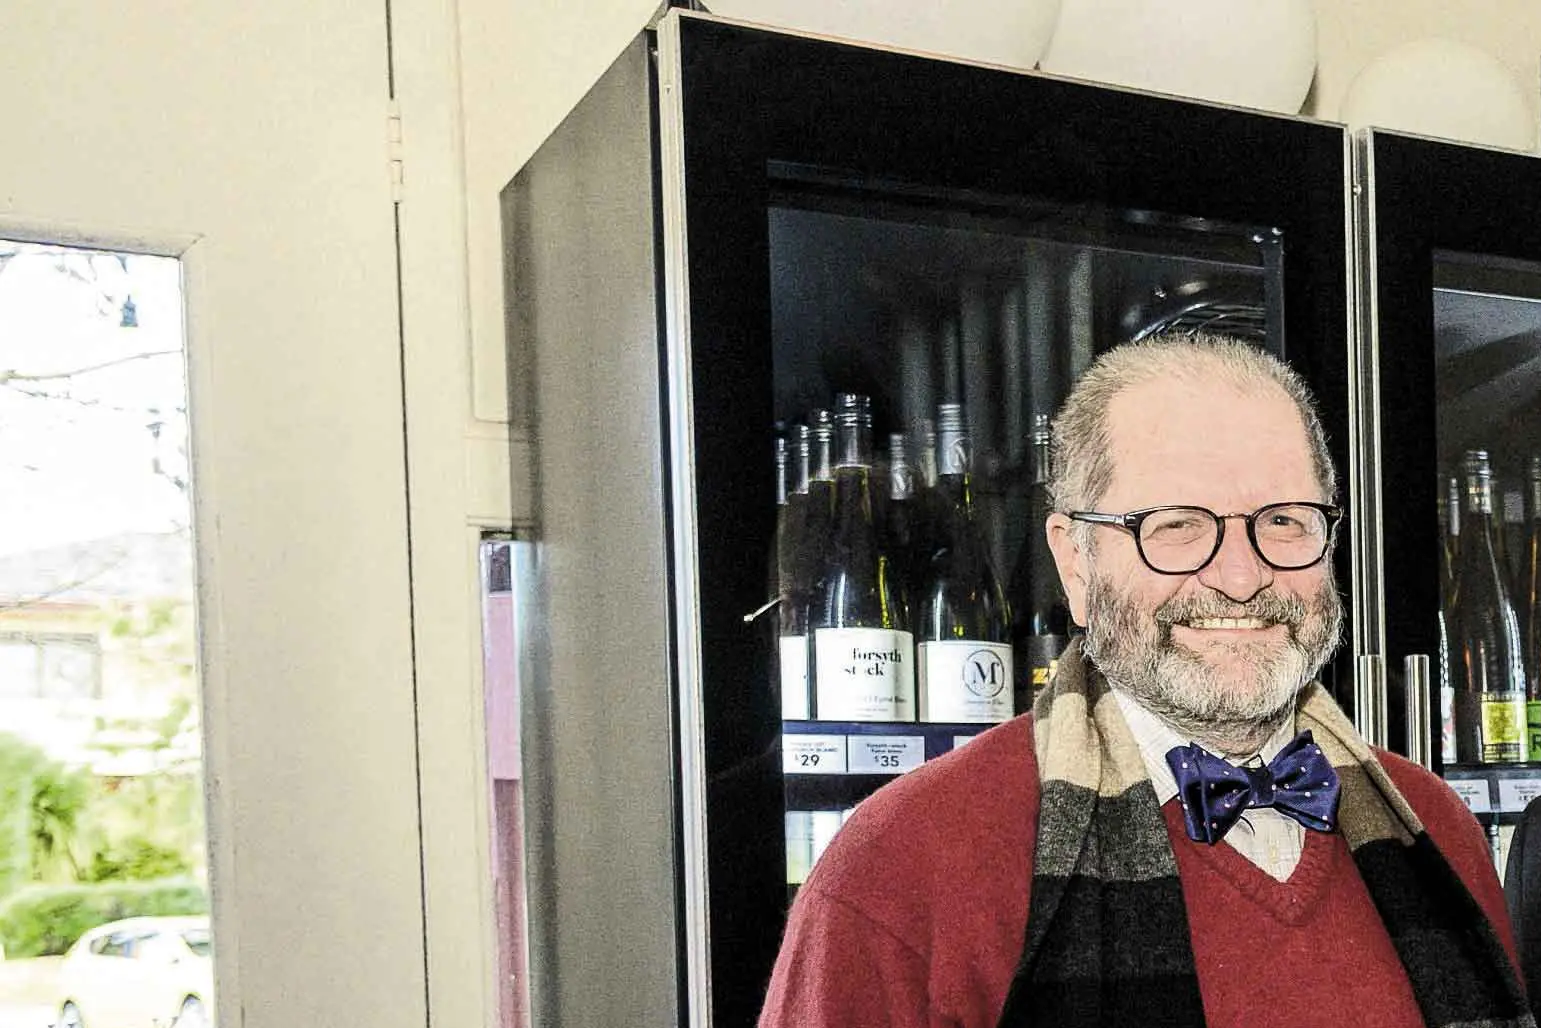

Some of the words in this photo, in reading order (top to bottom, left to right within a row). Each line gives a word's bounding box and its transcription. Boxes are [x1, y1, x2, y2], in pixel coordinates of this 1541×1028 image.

[843, 662, 885, 676] stck
[971, 660, 1001, 685] M
[874, 755, 900, 767] $35
